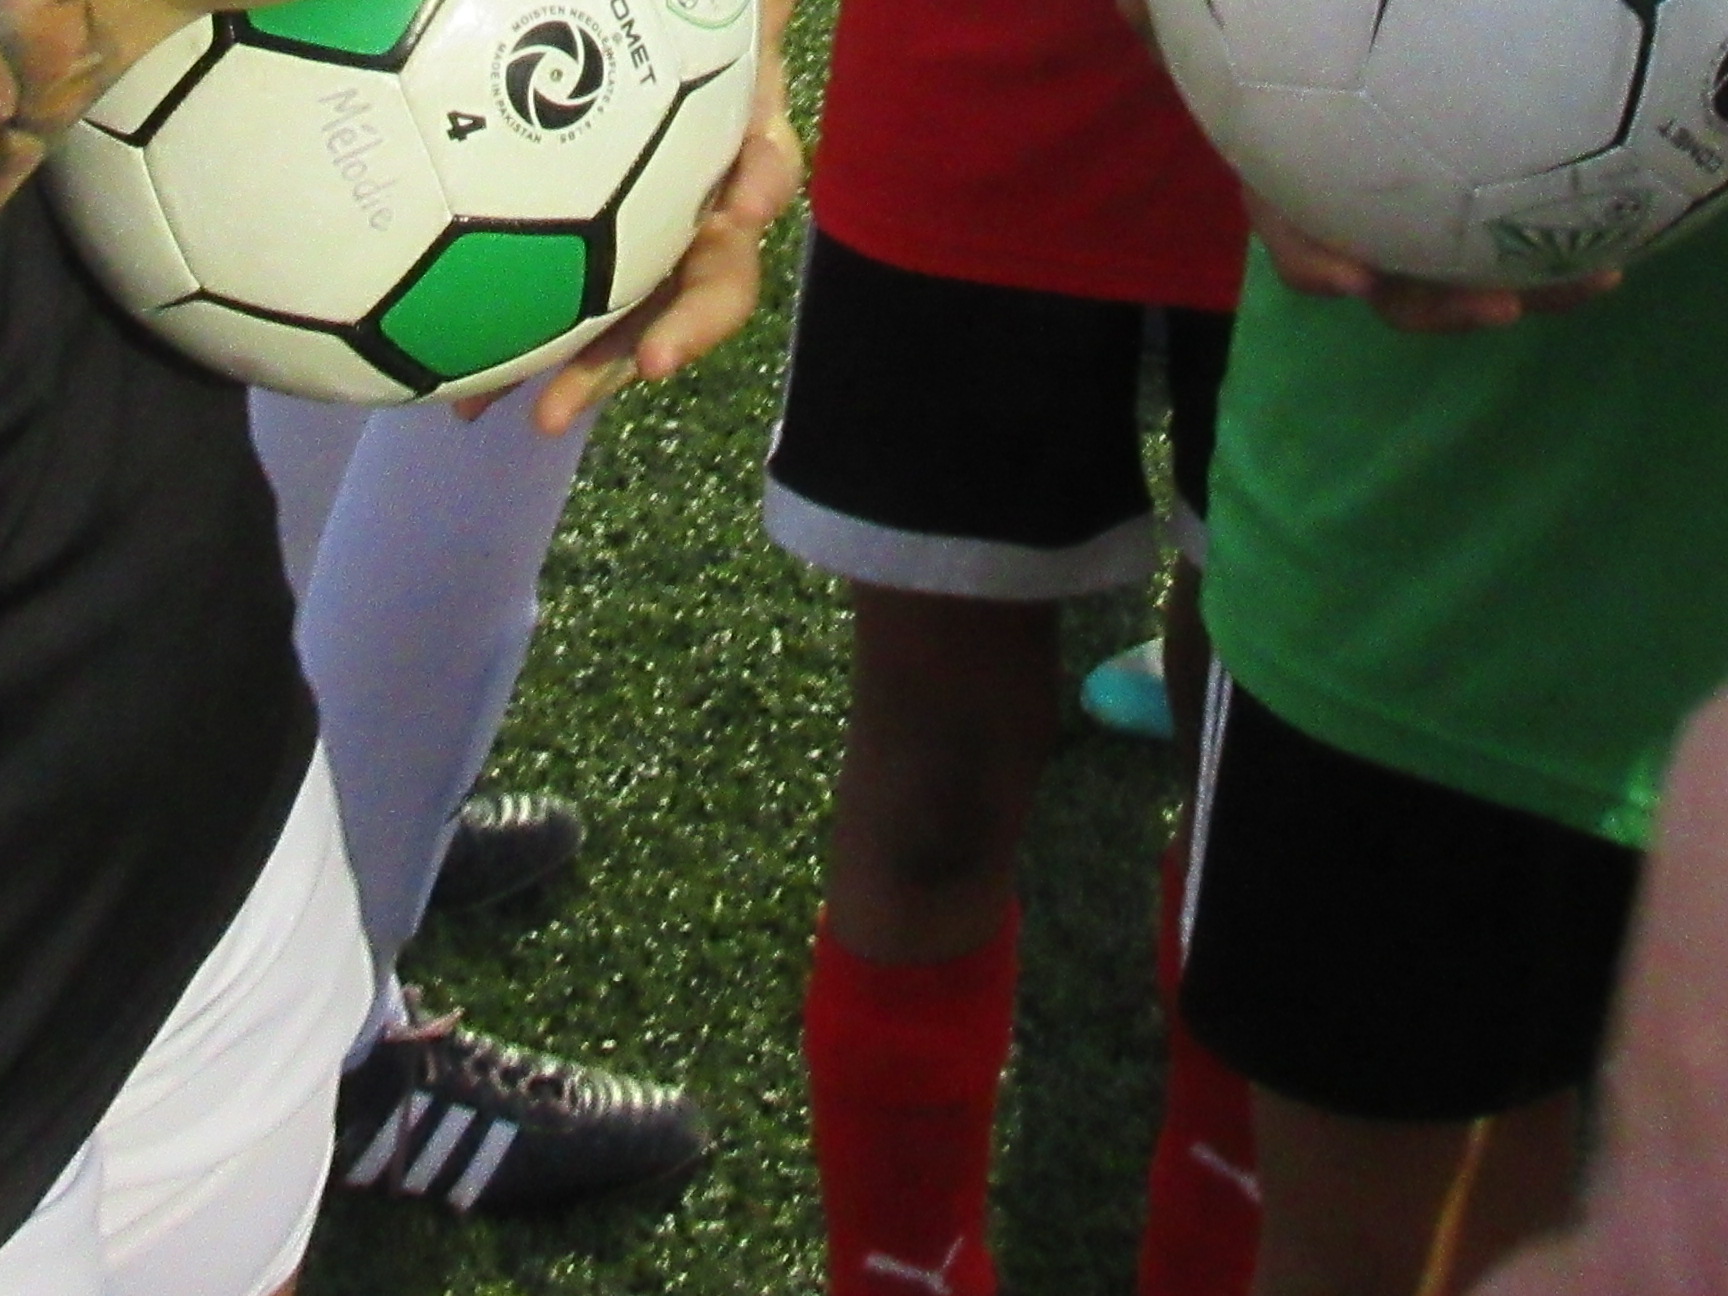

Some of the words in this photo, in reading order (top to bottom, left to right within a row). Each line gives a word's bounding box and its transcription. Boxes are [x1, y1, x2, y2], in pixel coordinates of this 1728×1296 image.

[512, 5, 565, 32] MOISTEN
[570, 7, 609, 46] NEEDLE
[490, 42, 507, 79] MADE
[491, 84, 504, 97] IN
[446, 110, 488, 143] 4
[496, 99, 543, 144] PAKISTAN
